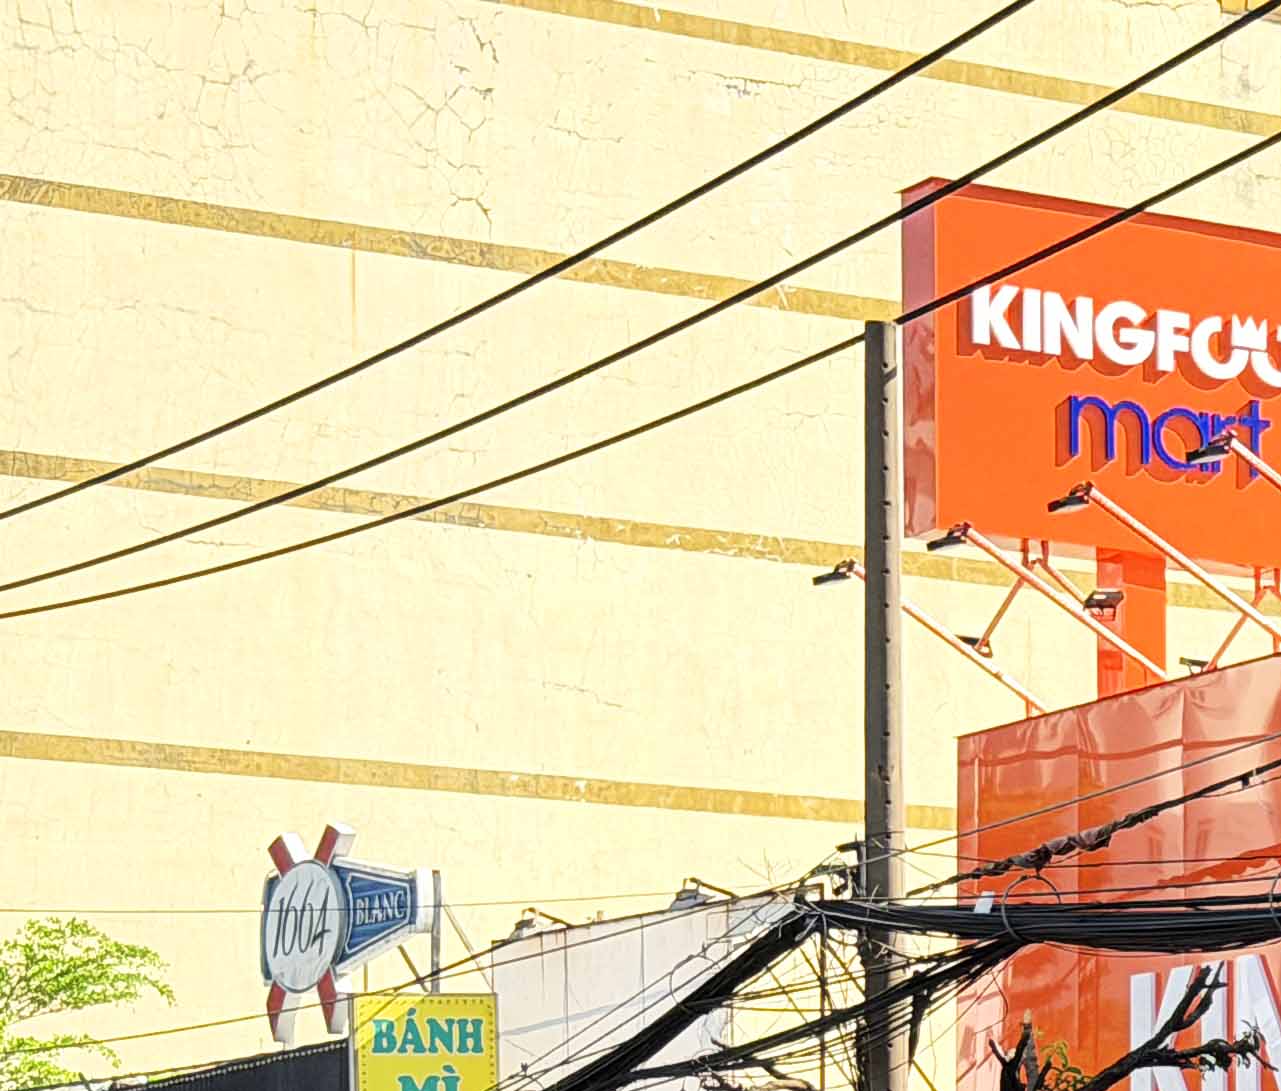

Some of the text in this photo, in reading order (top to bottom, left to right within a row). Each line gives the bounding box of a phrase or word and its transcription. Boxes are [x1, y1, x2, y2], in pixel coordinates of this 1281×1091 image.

[1070, 395, 1270, 479] mart
[273, 879, 332, 958] 1664
[356, 890, 405, 925] BLANC
[371, 1008, 484, 1055] BÁNH
